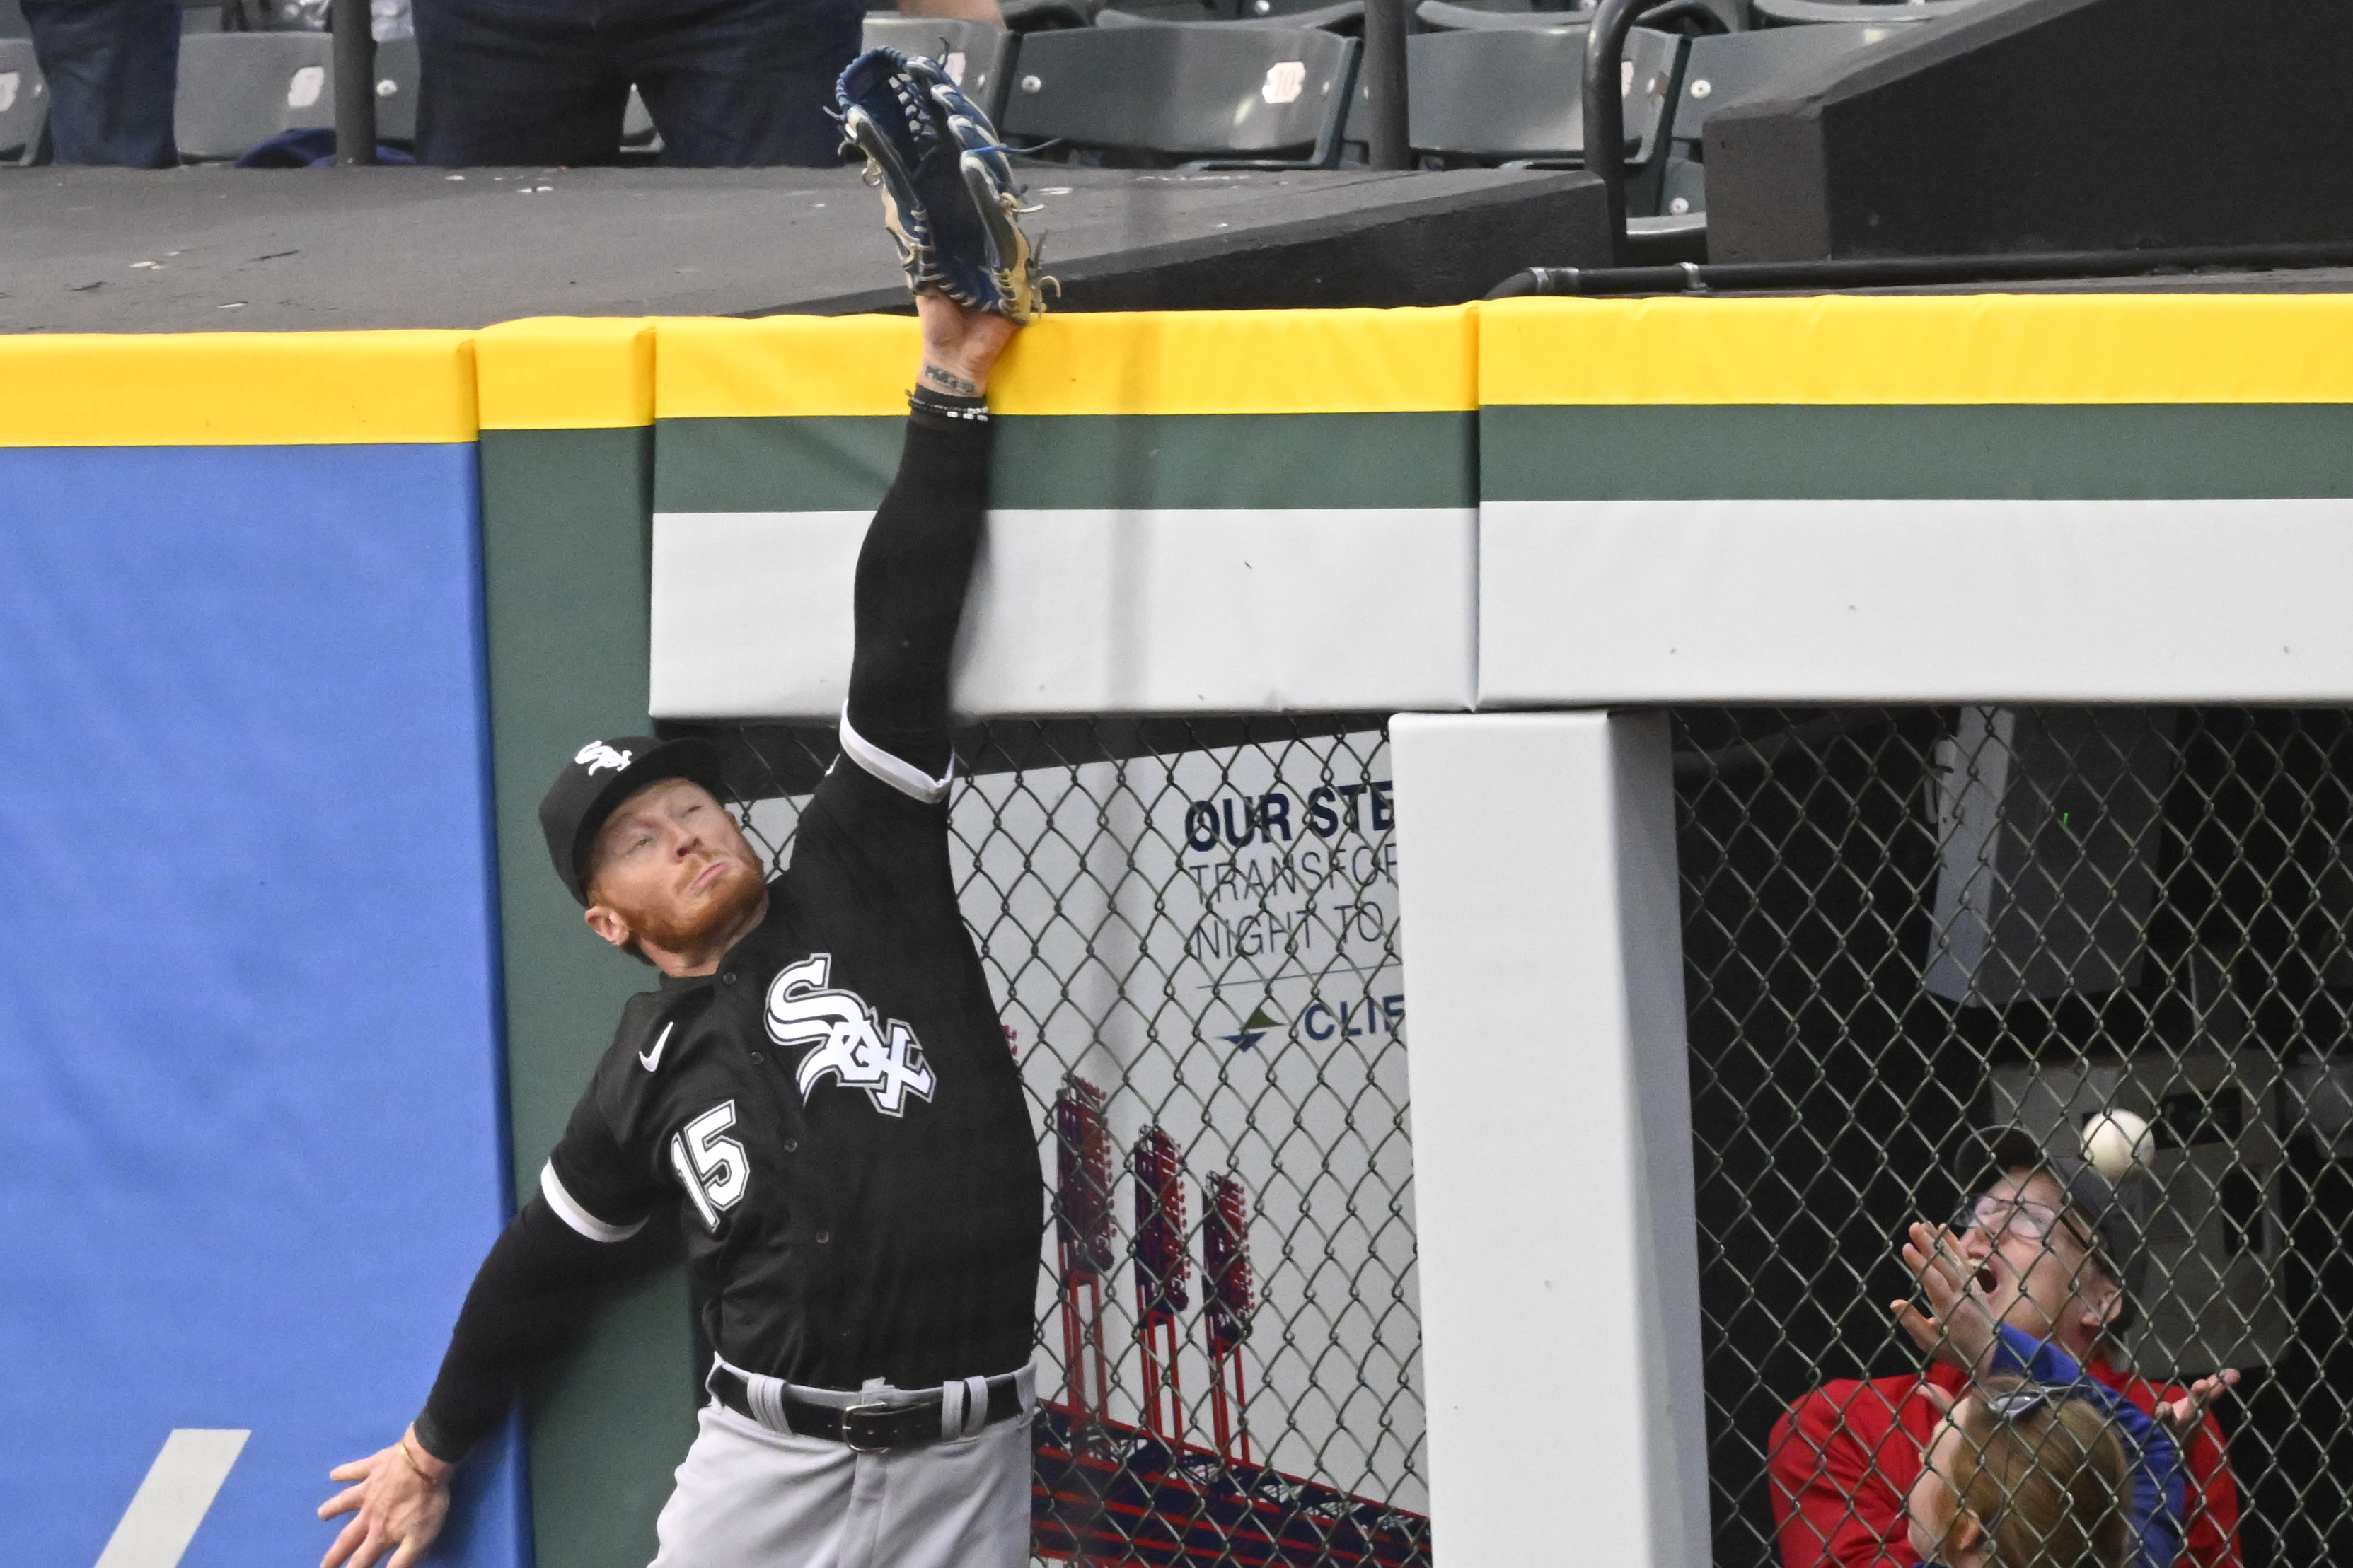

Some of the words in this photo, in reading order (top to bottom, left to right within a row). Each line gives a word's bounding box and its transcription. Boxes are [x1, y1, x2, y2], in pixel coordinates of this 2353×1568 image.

[1184, 793, 1293, 852] OUR
[1196, 910, 1313, 960] NIGHT
[1334, 901, 1383, 944] TO
[671, 1099, 750, 1233] 15
